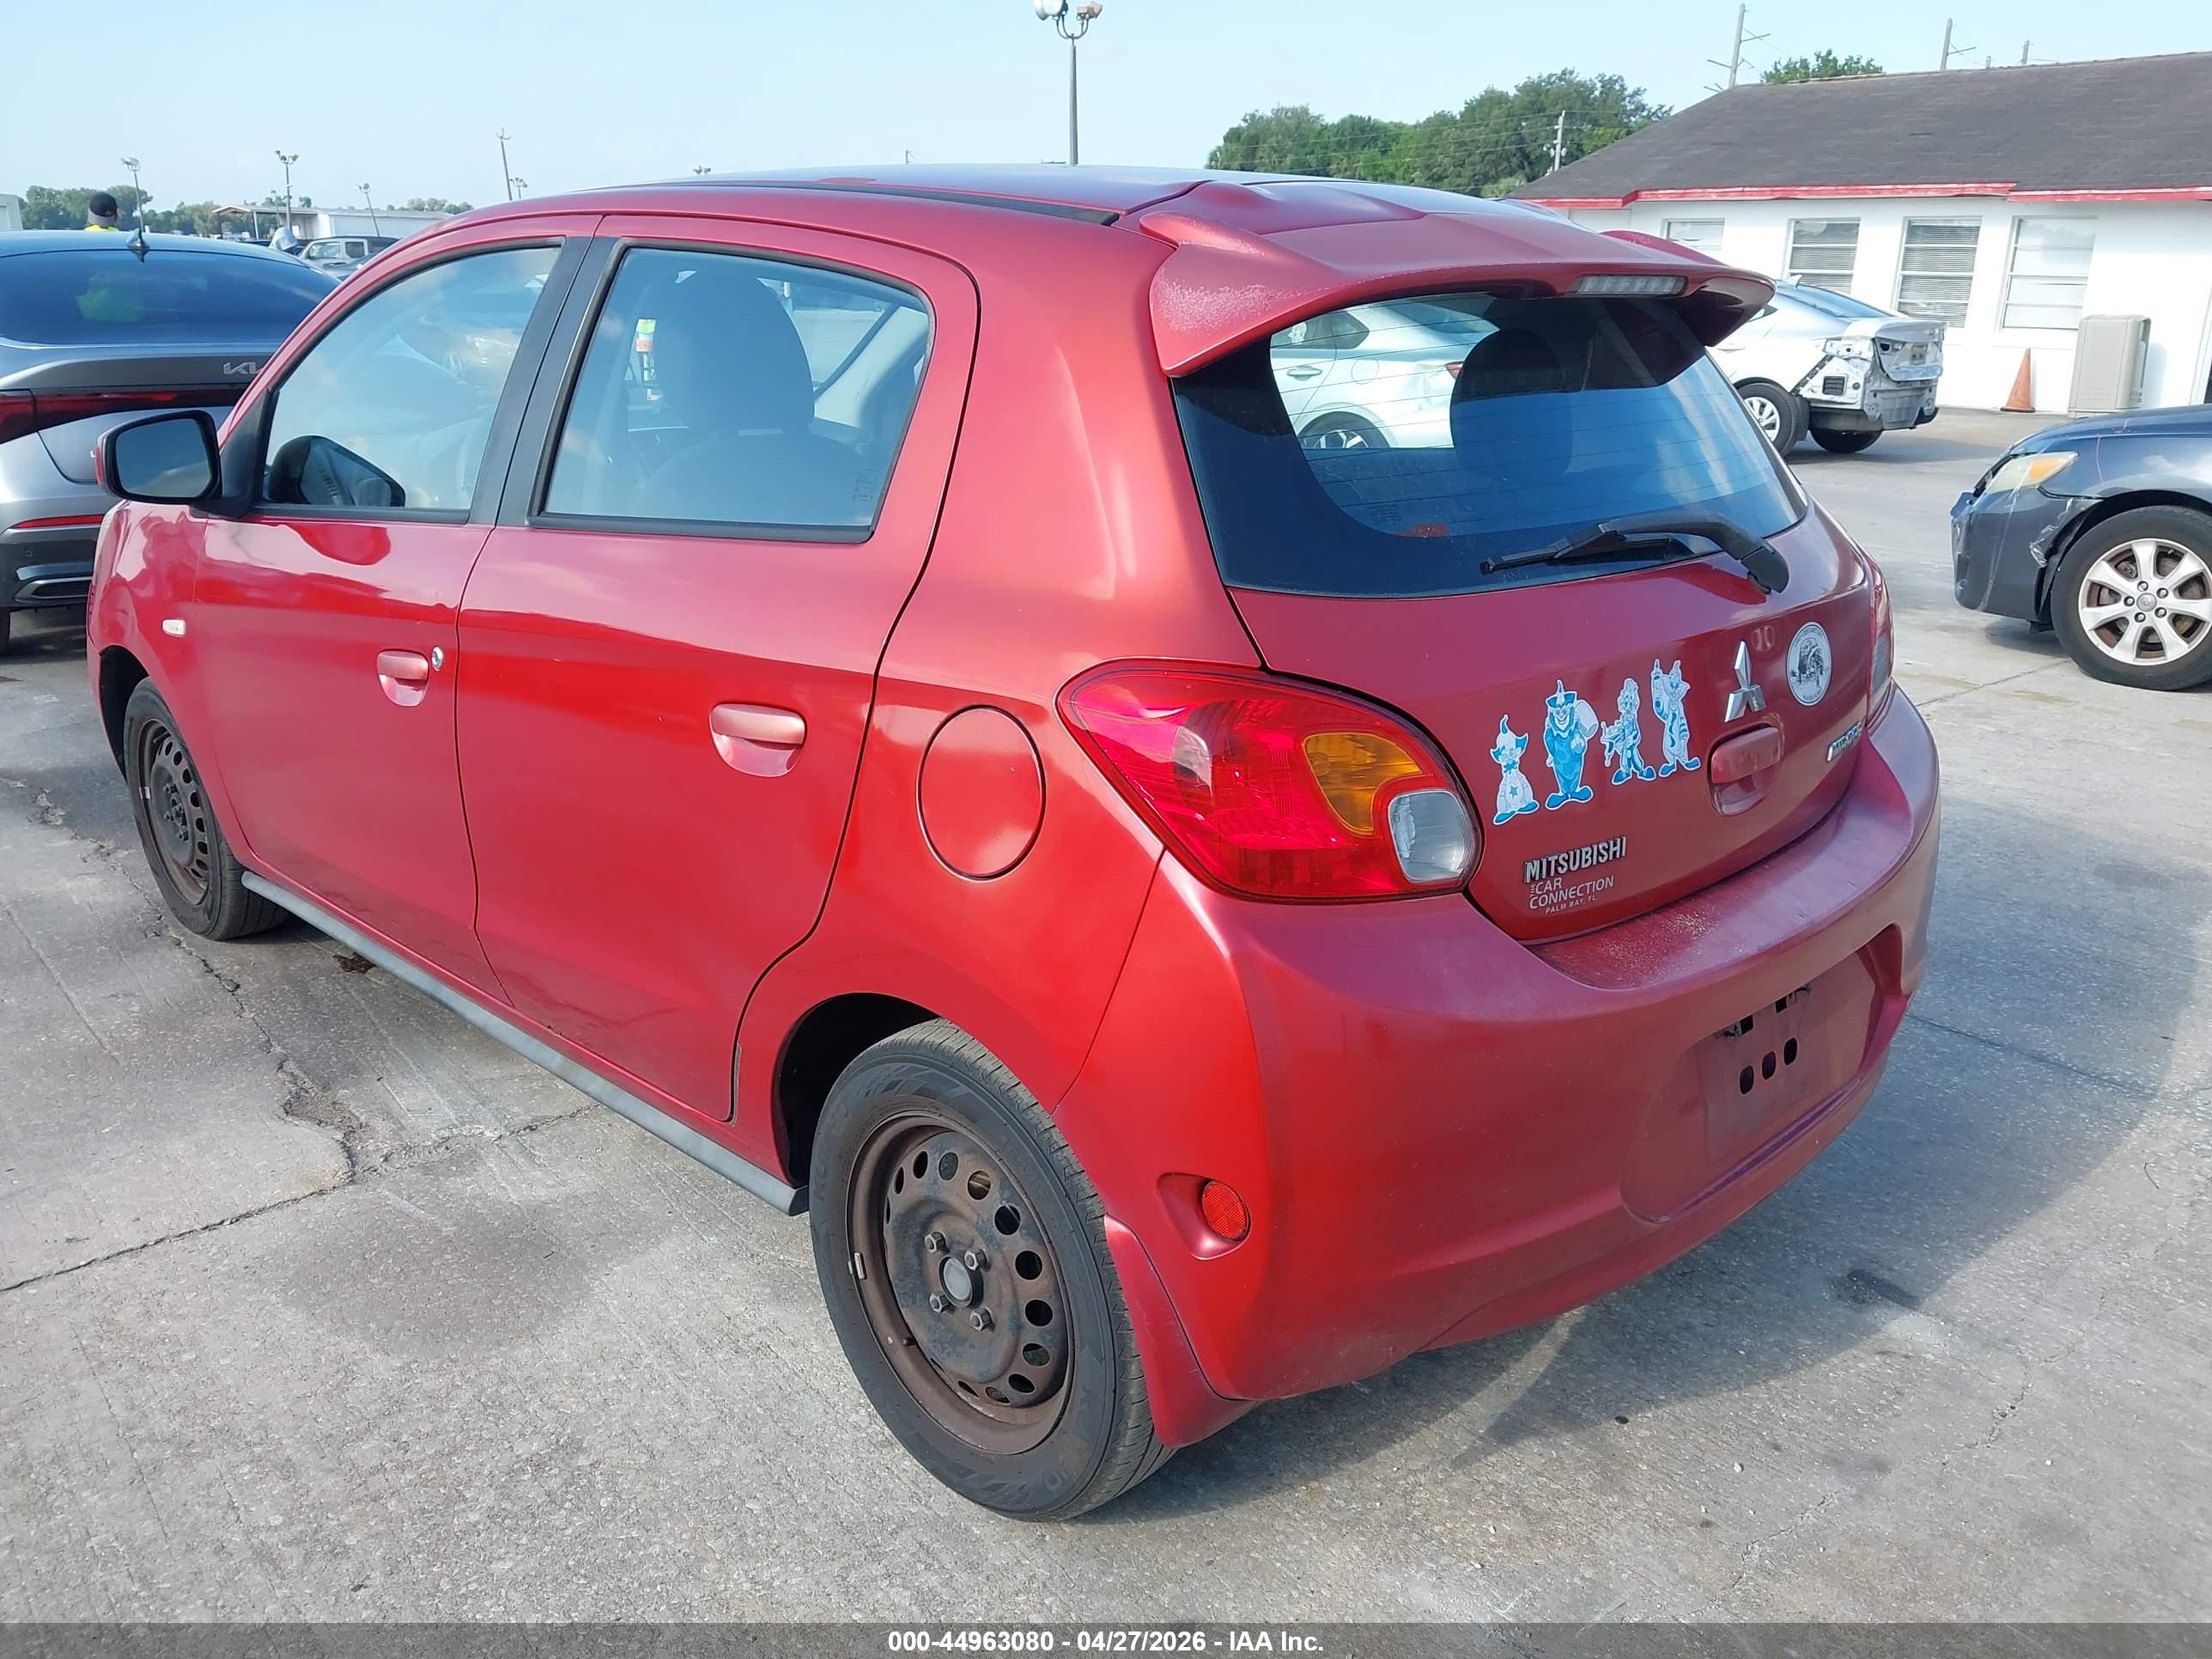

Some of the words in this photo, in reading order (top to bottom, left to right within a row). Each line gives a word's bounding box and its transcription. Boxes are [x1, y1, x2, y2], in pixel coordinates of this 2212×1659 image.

[223, 362, 263, 374] KI
[1524, 836, 1626, 884] MITSUBISHI
[1529, 875, 1614, 909] CONNECTION
[1535, 877, 1562, 894] CAR
[1546, 903, 1567, 915] PALM
